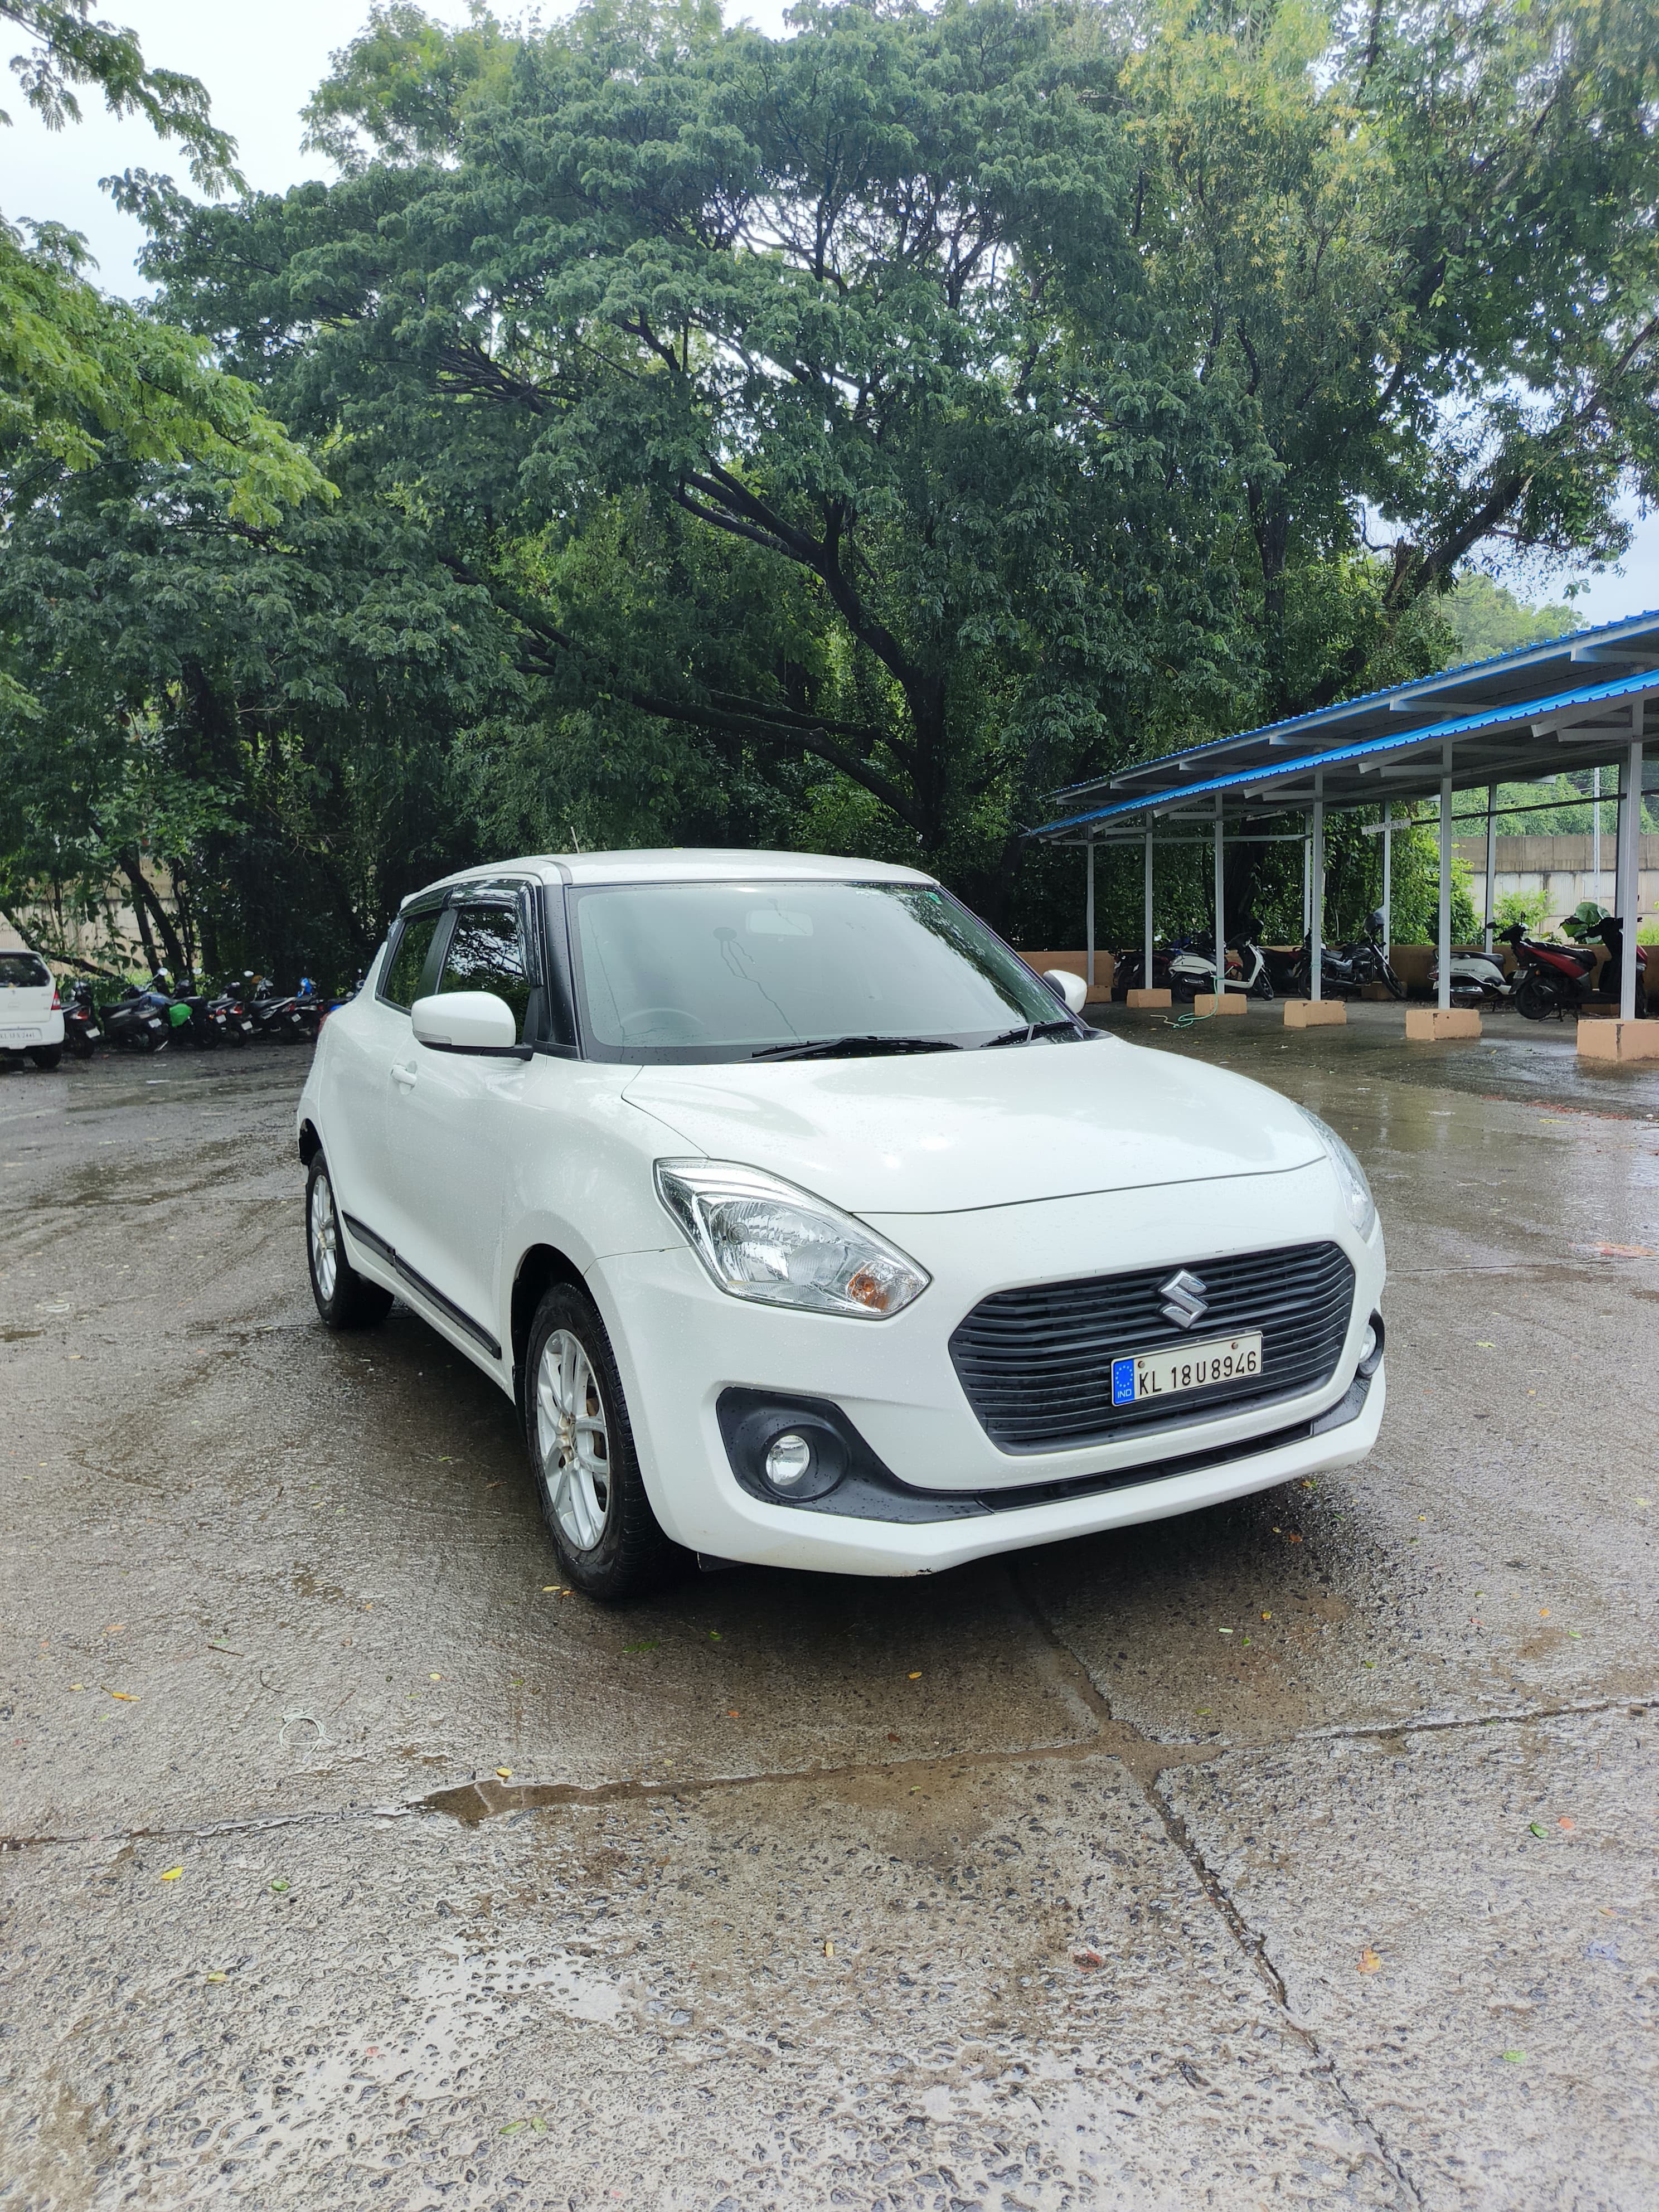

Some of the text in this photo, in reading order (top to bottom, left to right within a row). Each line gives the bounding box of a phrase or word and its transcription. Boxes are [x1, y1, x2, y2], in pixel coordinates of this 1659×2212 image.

[1139, 1351, 1257, 1395] KL 18U8946
[1117, 1389, 1132, 1398] IND
